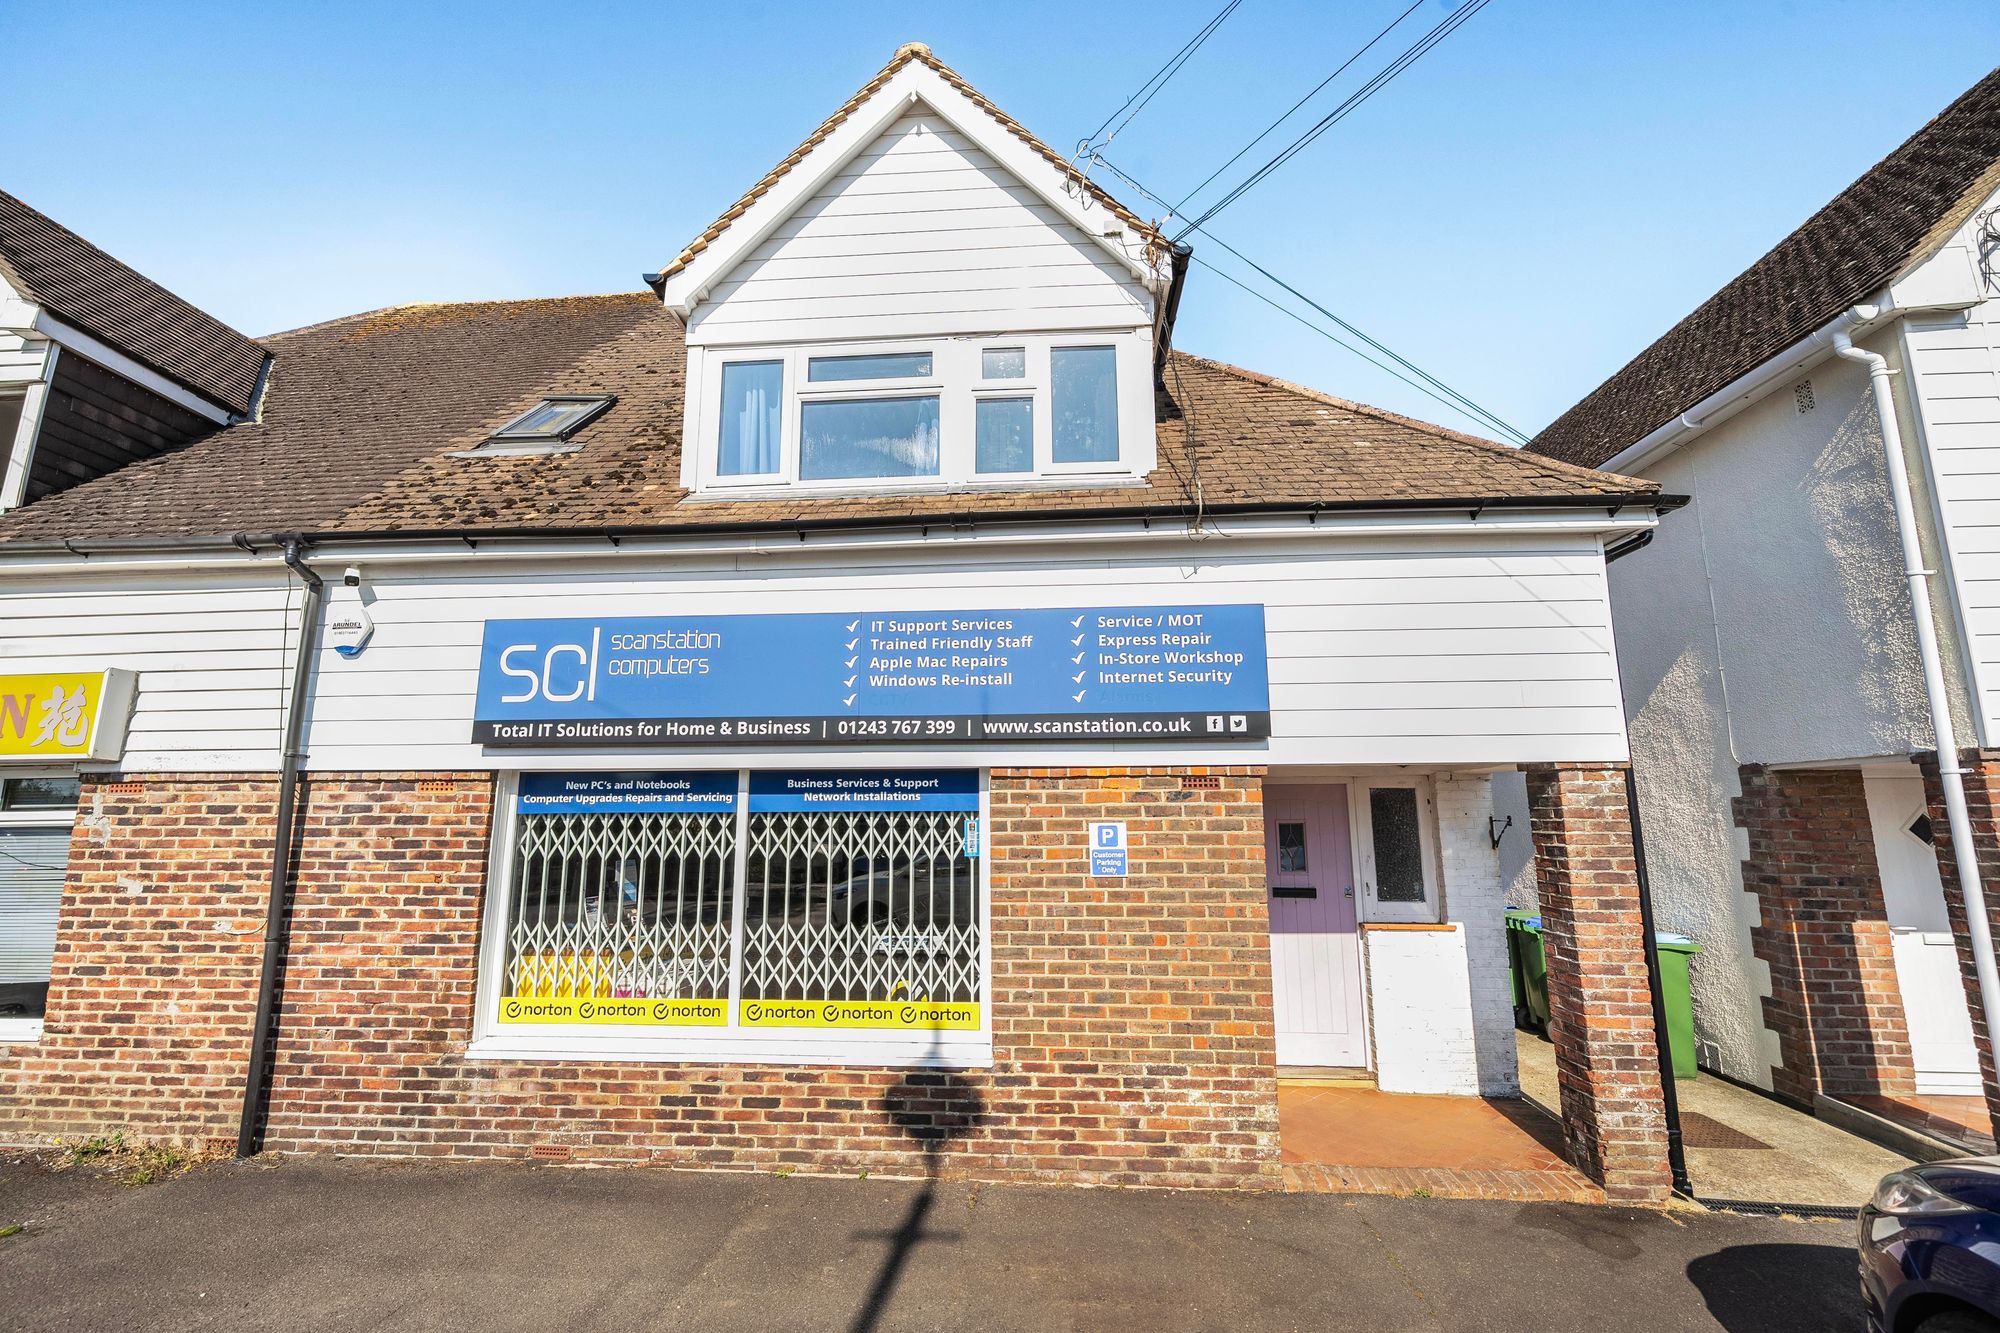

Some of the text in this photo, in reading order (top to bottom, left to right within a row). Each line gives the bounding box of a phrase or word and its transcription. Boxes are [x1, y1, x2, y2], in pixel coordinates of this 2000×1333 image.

[871, 618, 1013, 635] IT Support Services
[1097, 614, 1153, 628] Service
[1168, 613, 1203, 627] MOT
[611, 629, 721, 650] scanstation
[870, 634, 1034, 653] Trained Friendly Staff
[1098, 631, 1212, 650] Express Repair
[869, 654, 1008, 672] Apple Mac Repairs
[1099, 650, 1244, 667] In-Store Workshop
[608, 654, 710, 679] computers
[869, 671, 1012, 688] Windows Re-install
[1099, 668, 1233, 686] Internet Security
[492, 723, 534, 738] Total
[537, 723, 554, 738] IT
[556, 722, 633, 738] Solutions
[637, 721, 662, 737] for
[666, 722, 716, 736] Home
[719, 721, 733, 736] &
[737, 720, 811, 736] Business
[838, 720, 887, 735] 01243
[891, 720, 922, 735] 767
[925, 720, 956, 735] 399
[983, 717, 1192, 735] www.scanstation.co.uk
[565, 780, 589, 791] New
[614, 780, 634, 790] and
[636, 780, 690, 790] Notebooks
[787, 778, 939, 790] Business Services & Support
[523, 792, 733, 805] Computer Upgrades Repairs and Servicing
[803, 790, 921, 803] Network Installations
[524, 1003, 572, 1017] norton
[597, 1003, 646, 1018] norton
[671, 1004, 721, 1018] norton
[765, 1006, 815, 1019] norton
[841, 1007, 893, 1020] norton
[919, 1008, 971, 1021] norton
